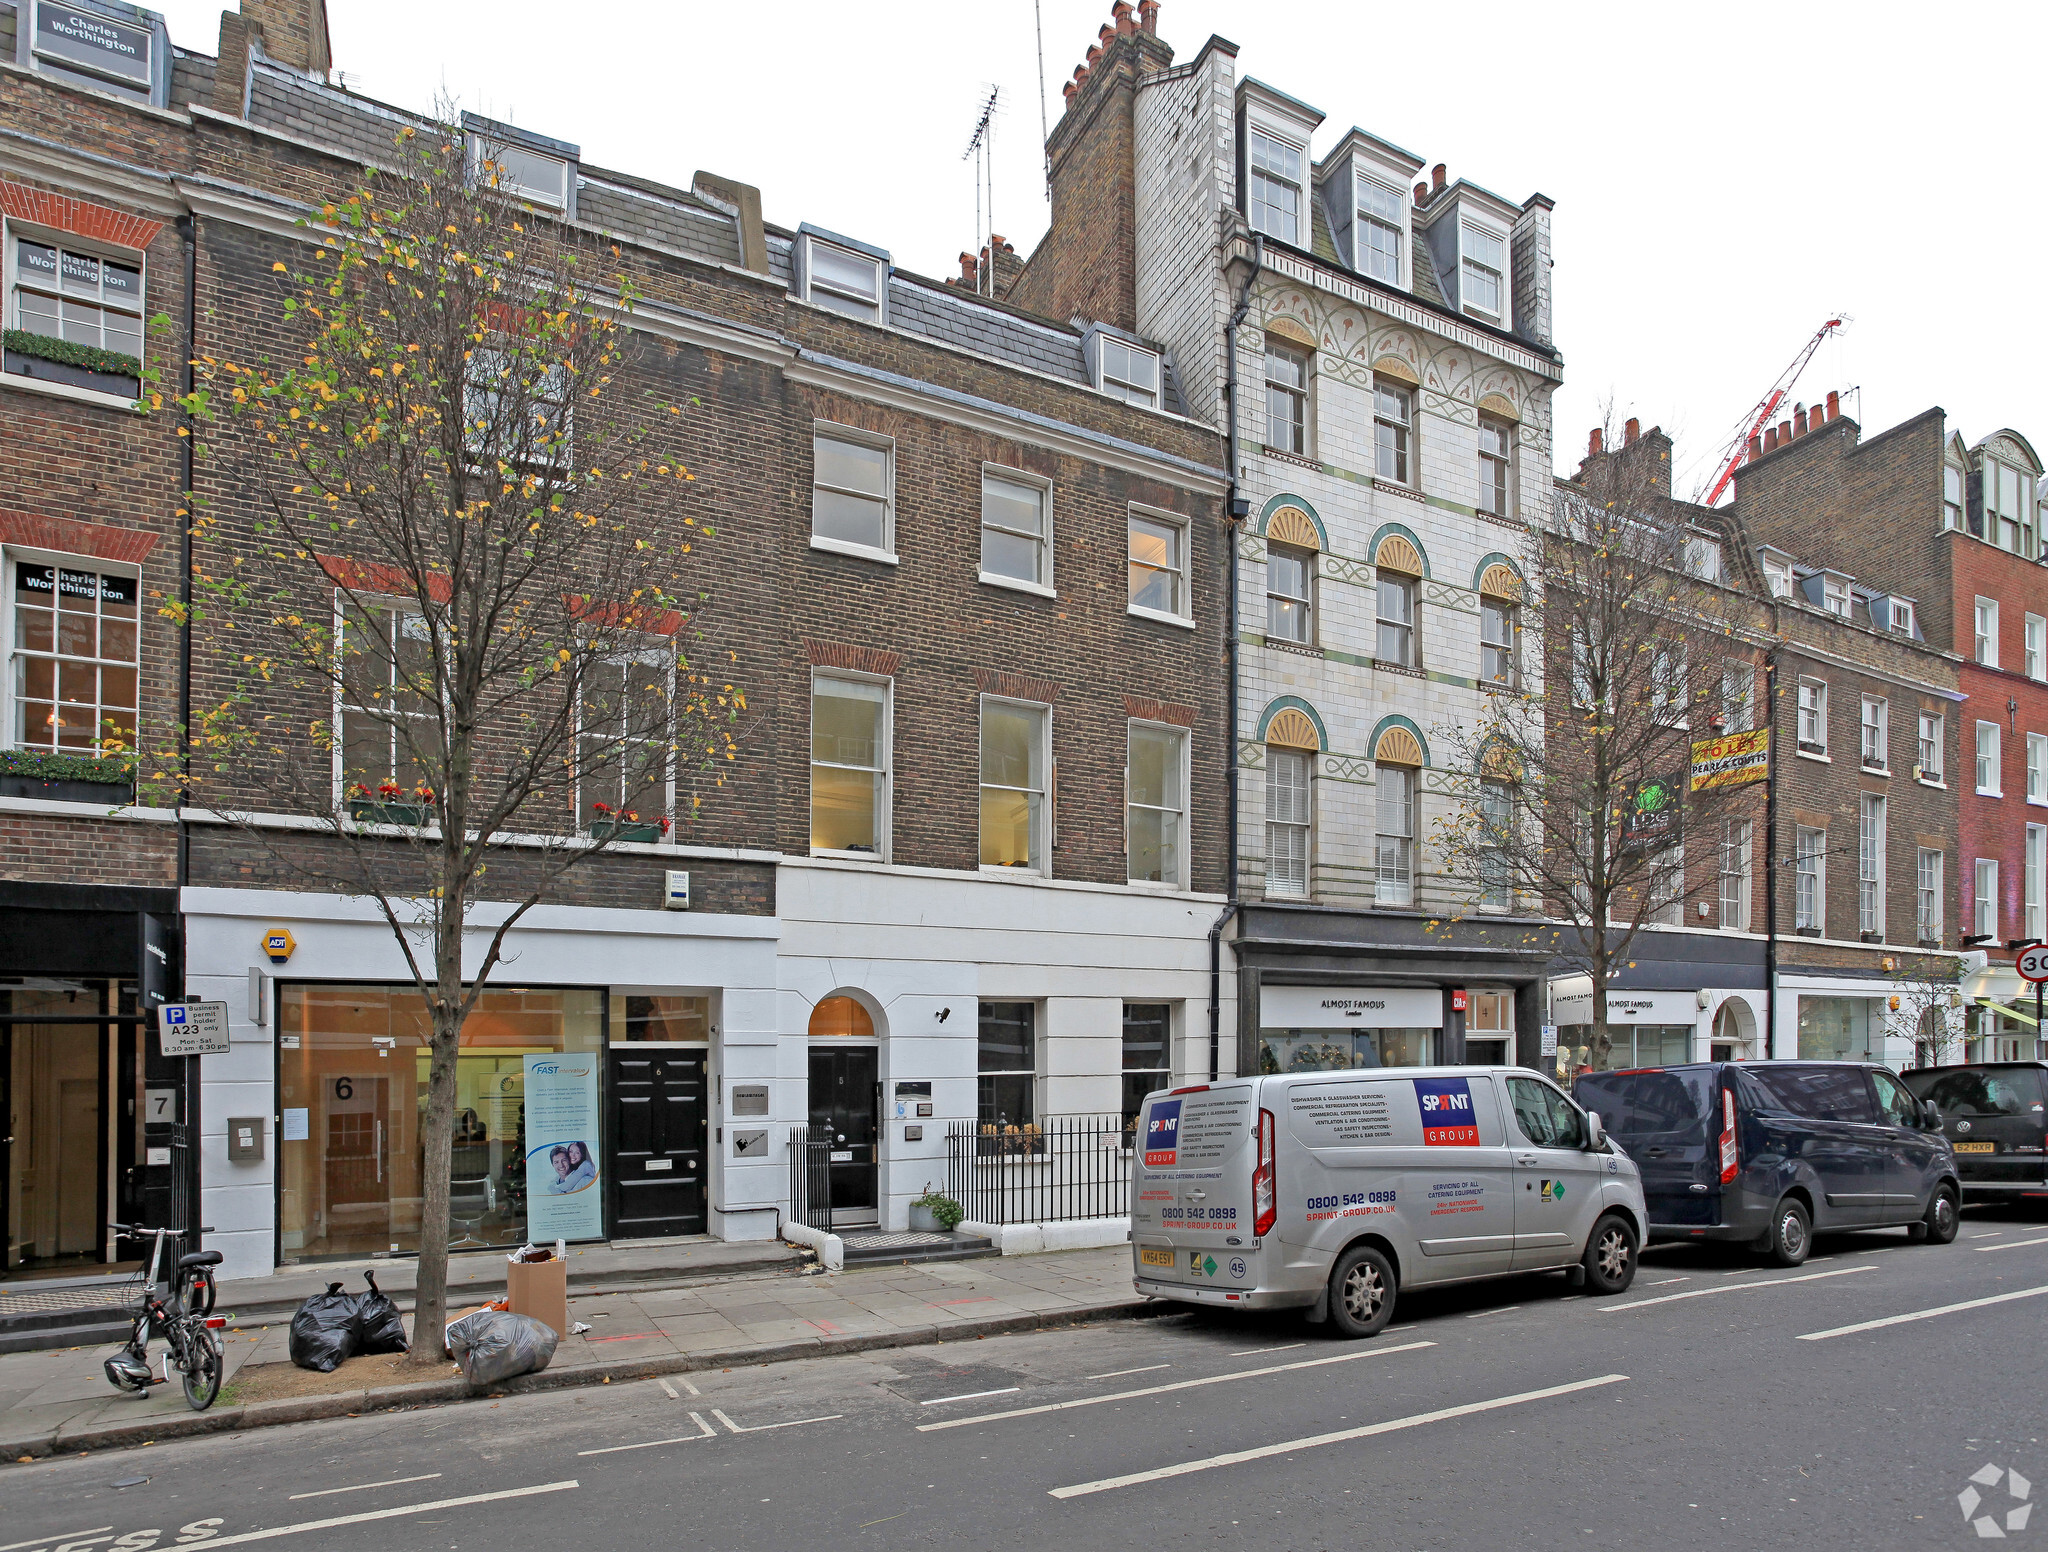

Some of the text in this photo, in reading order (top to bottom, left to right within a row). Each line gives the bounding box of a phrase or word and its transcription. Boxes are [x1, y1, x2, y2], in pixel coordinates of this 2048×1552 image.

[69, 17, 118, 39] Charles
[52, 20, 135, 54] Worthington
[47, 249, 111, 272] Charles
[28, 254, 126, 287] Worthington
[44, 570, 108, 586] Charles
[26, 577, 124, 599] Worthington
[1701, 739, 1758, 759] TO LET
[1692, 762, 1720, 774] PEARL
[1733, 753, 1766, 766] COUTTS
[1321, 1000, 1385, 1009] ALMOST FAMOUS
[1608, 1000, 1653, 1009] ALMOST FAMOUS
[170, 1009, 183, 1022] P
[172, 1025, 199, 1035] A23
[537, 1066, 559, 1074] FAST
[656, 1068, 662, 1076] 6
[336, 1076, 353, 1100] 6
[155, 1097, 168, 1114] 7
[1430, 1130, 1473, 1142] GROUP
[1953, 1143, 1991, 1152] 62 HXR
[1148, 1154, 1173, 1162] GROUP
[1609, 1161, 1616, 1170] 45
[1433, 1182, 1460, 1190] SERVICING
[1307, 1190, 1396, 1210] 0800 542 0898
[1449, 1199, 1478, 1207] NATIONWIDE
[1162, 1208, 1184, 1218] 0800
[1187, 1208, 1204, 1219] 542
[1208, 1208, 1237, 1219] 0898
[1306, 1205, 1396, 1221] SPRINT-GROUP.CO.UK
[1430, 1205, 1484, 1216] EMERGENCY RESPONSE
[1162, 1221, 1237, 1230] SPRINT-GROUP.CO.UK
[1143, 1249, 1171, 1264] VK64 ESV
[1231, 1263, 1244, 1273] 45
